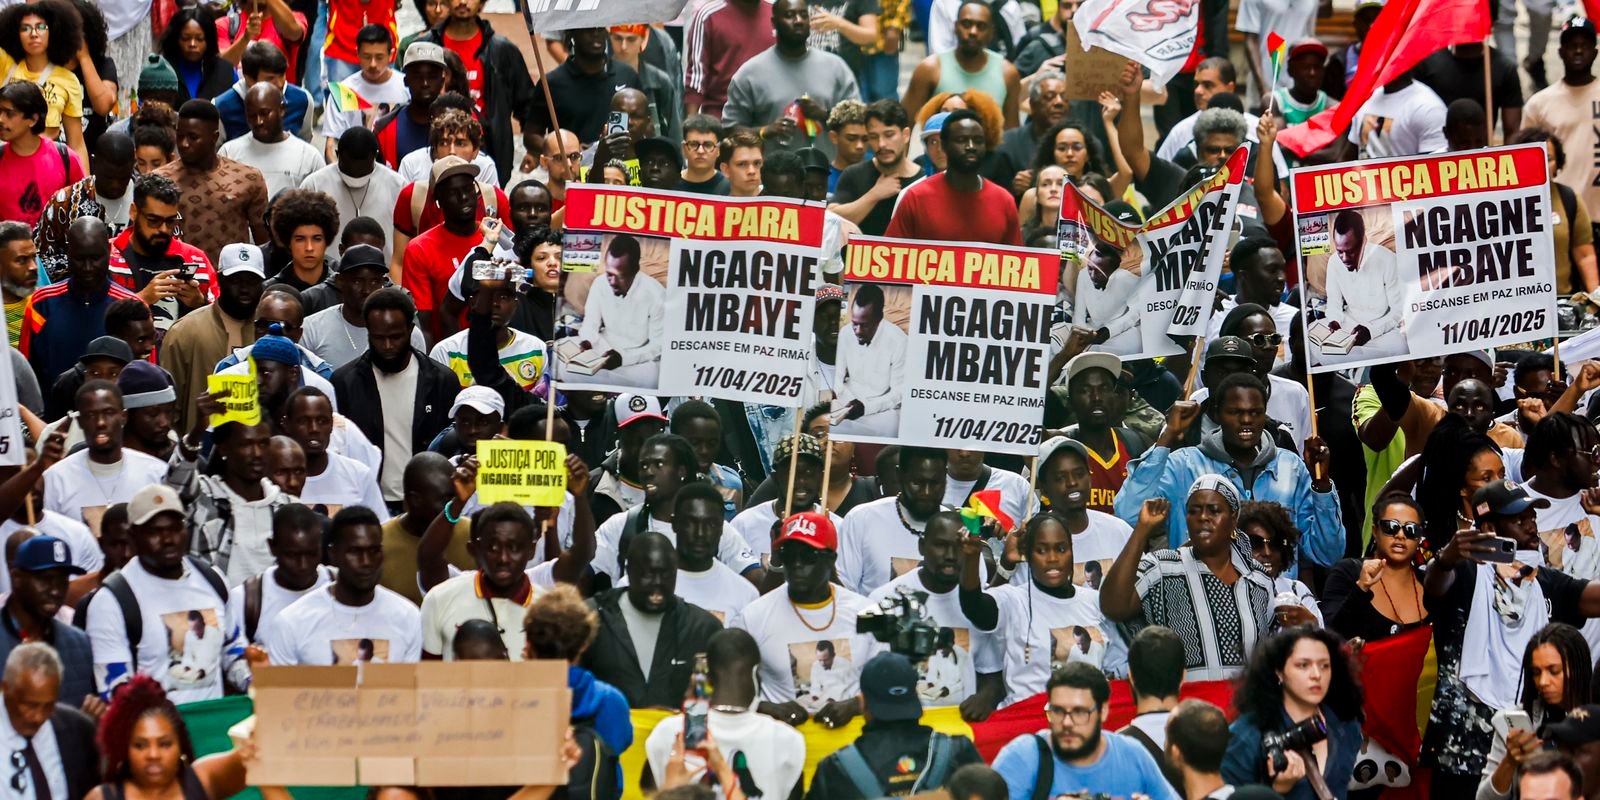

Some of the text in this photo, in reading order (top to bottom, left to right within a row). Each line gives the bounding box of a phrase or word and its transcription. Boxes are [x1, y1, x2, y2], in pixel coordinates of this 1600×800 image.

[1314, 154, 1519, 208] JUSTIÇA PARA
[590, 194, 800, 241] JUSTIÇA PARA
[1402, 195, 1544, 249] NGAGNE
[677, 248, 818, 297] NGAGNE
[962, 252, 1041, 289] PARA
[1418, 238, 1535, 292] MBAYE
[684, 292, 803, 340] MBAYE
[1411, 282, 1553, 313] DESCANSE EM PAZ IRMÃO
[670, 340, 731, 352] DESCANSE
[733, 342, 751, 353] EM
[752, 345, 775, 357] PAZ
[925, 340, 1043, 389] MBAYE
[911, 388, 970, 402] DESCANSE
[973, 393, 991, 404] EM
[993, 394, 1015, 406] PAZ
[481, 472, 563, 487] NGANGE MBAYE
[486, 448, 557, 472] JUSTIÇA POR
